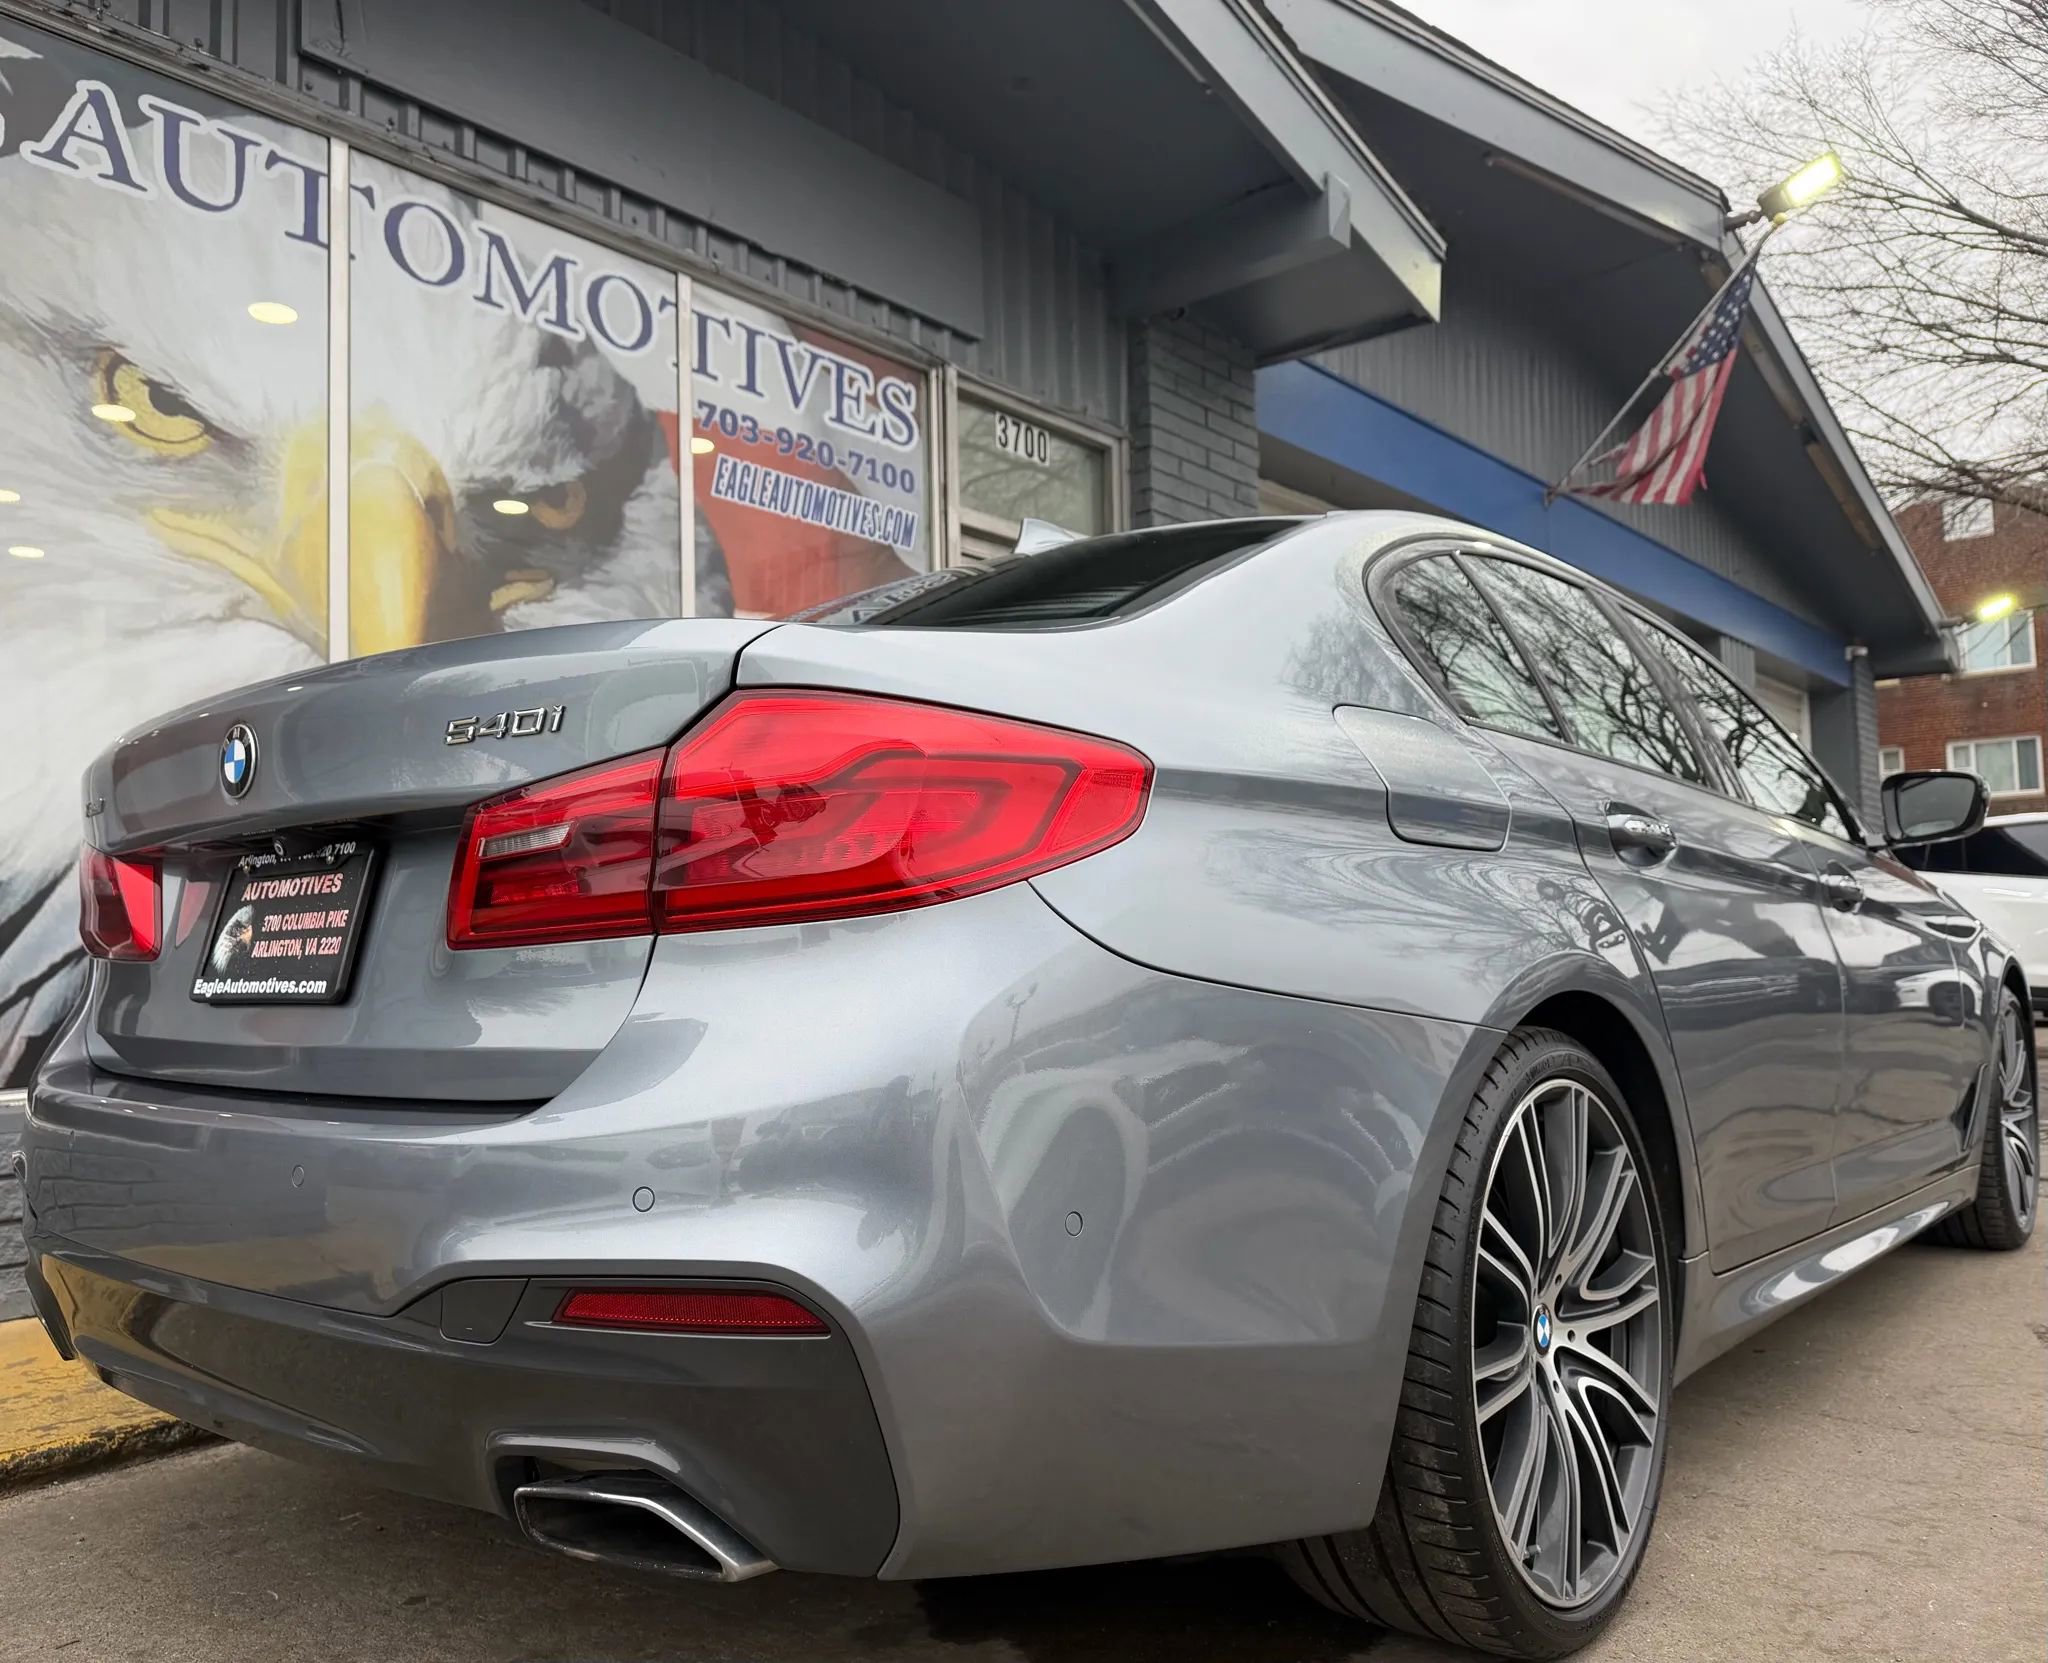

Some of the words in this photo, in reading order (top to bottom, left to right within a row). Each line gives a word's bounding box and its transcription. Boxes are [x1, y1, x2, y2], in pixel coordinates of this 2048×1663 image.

[29, 87, 917, 448] AUTOMOTIVES
[696, 399, 916, 494] 703-920-7100
[997, 414, 1047, 463] 3700
[713, 456, 918, 549] EAGLEAUTOMOTIVES.COM
[444, 704, 567, 746] 540i
[238, 854, 277, 869] Arlington,
[242, 873, 344, 901] AUTOMOTIVES
[263, 914, 281, 932] 3700
[282, 911, 325, 931] COLUMBIA
[326, 910, 349, 928] PIKE
[252, 939, 303, 960] ARLINGTON,
[305, 938, 317, 956] VA
[318, 937, 342, 955] 2220
[193, 978, 327, 997] EagleAutomotives.com
